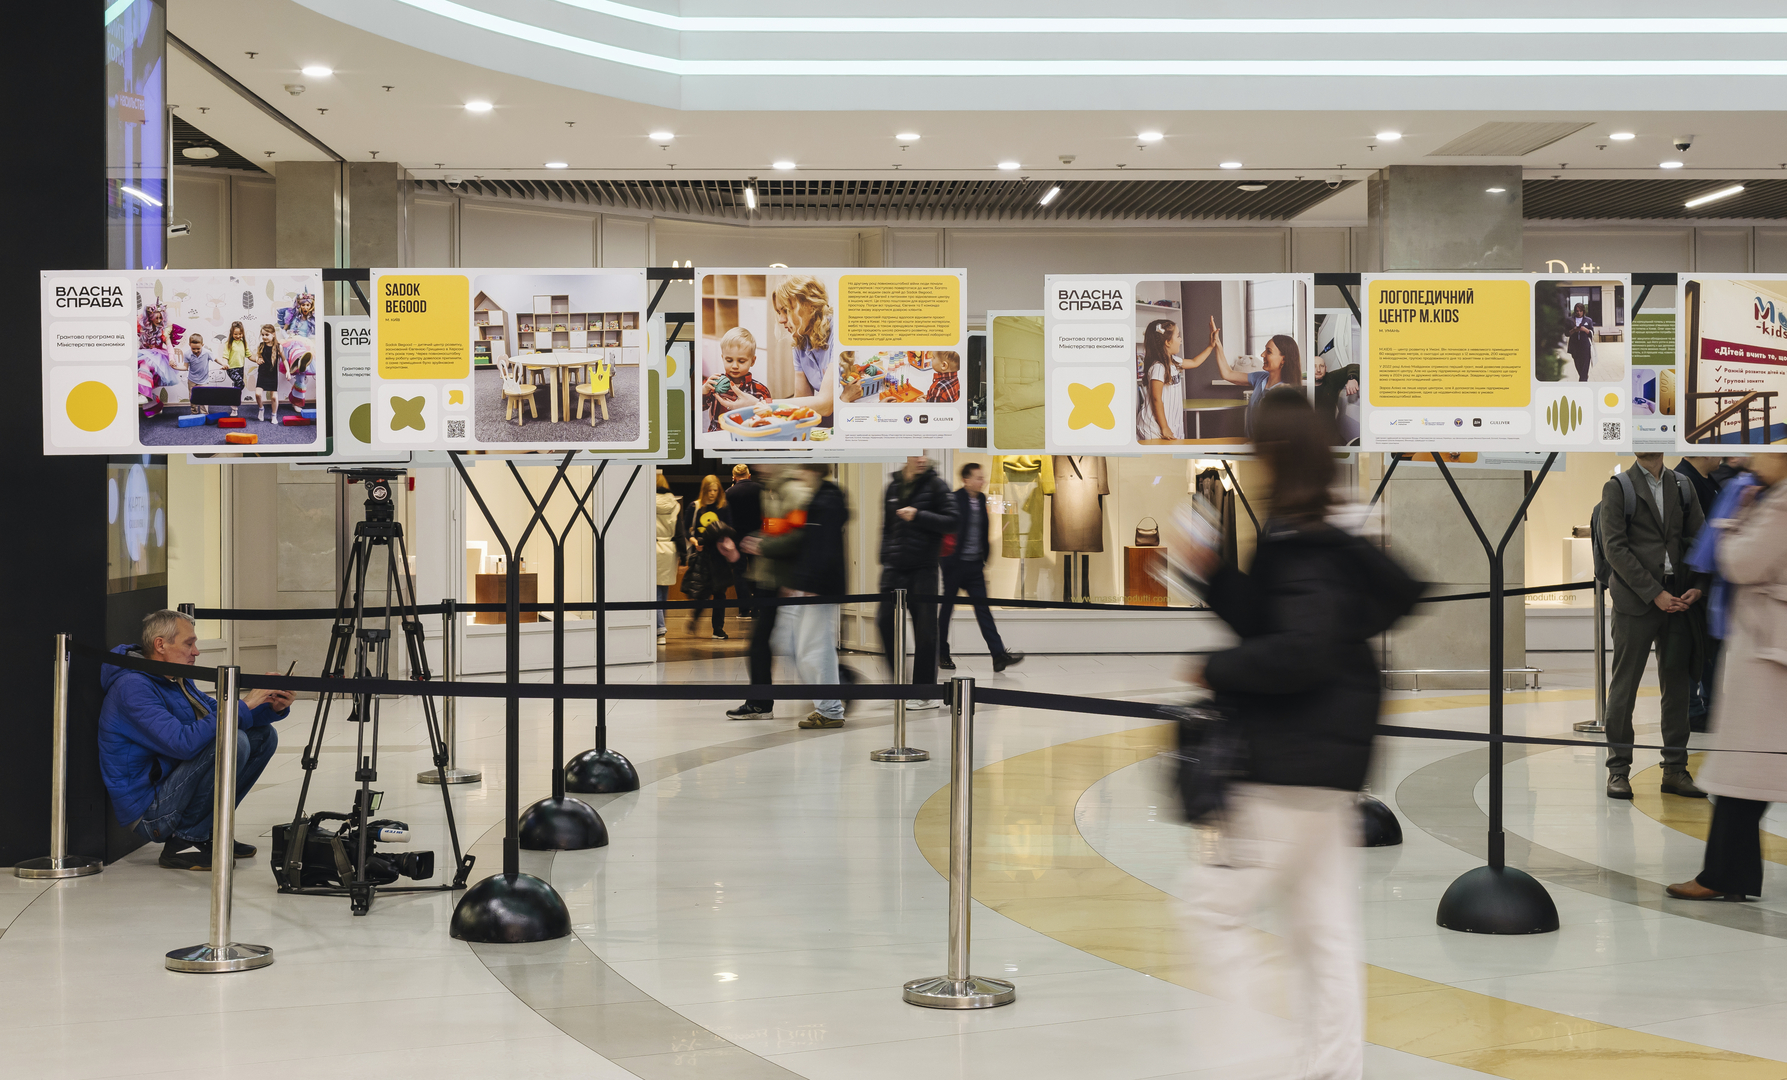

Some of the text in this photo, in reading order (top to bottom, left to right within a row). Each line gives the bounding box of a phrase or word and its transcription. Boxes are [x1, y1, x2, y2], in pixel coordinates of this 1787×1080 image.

[55, 286, 123, 297] ВЛАСНА
[385, 283, 420, 296] SADOK
[1058, 290, 1123, 300] ВЛАСНА
[1379, 288, 1474, 305] ЛОГОПЕДИЧНИЙ
[56, 297, 123, 308] СПРАВА
[385, 300, 427, 313] BEGOOD
[1058, 301, 1123, 311] СПРАВА
[1379, 309, 1459, 324] ЦЕНТР M.KIDS
[341, 328, 370, 336] ВЛА
[1714, 346, 1744, 357] «Дітей
